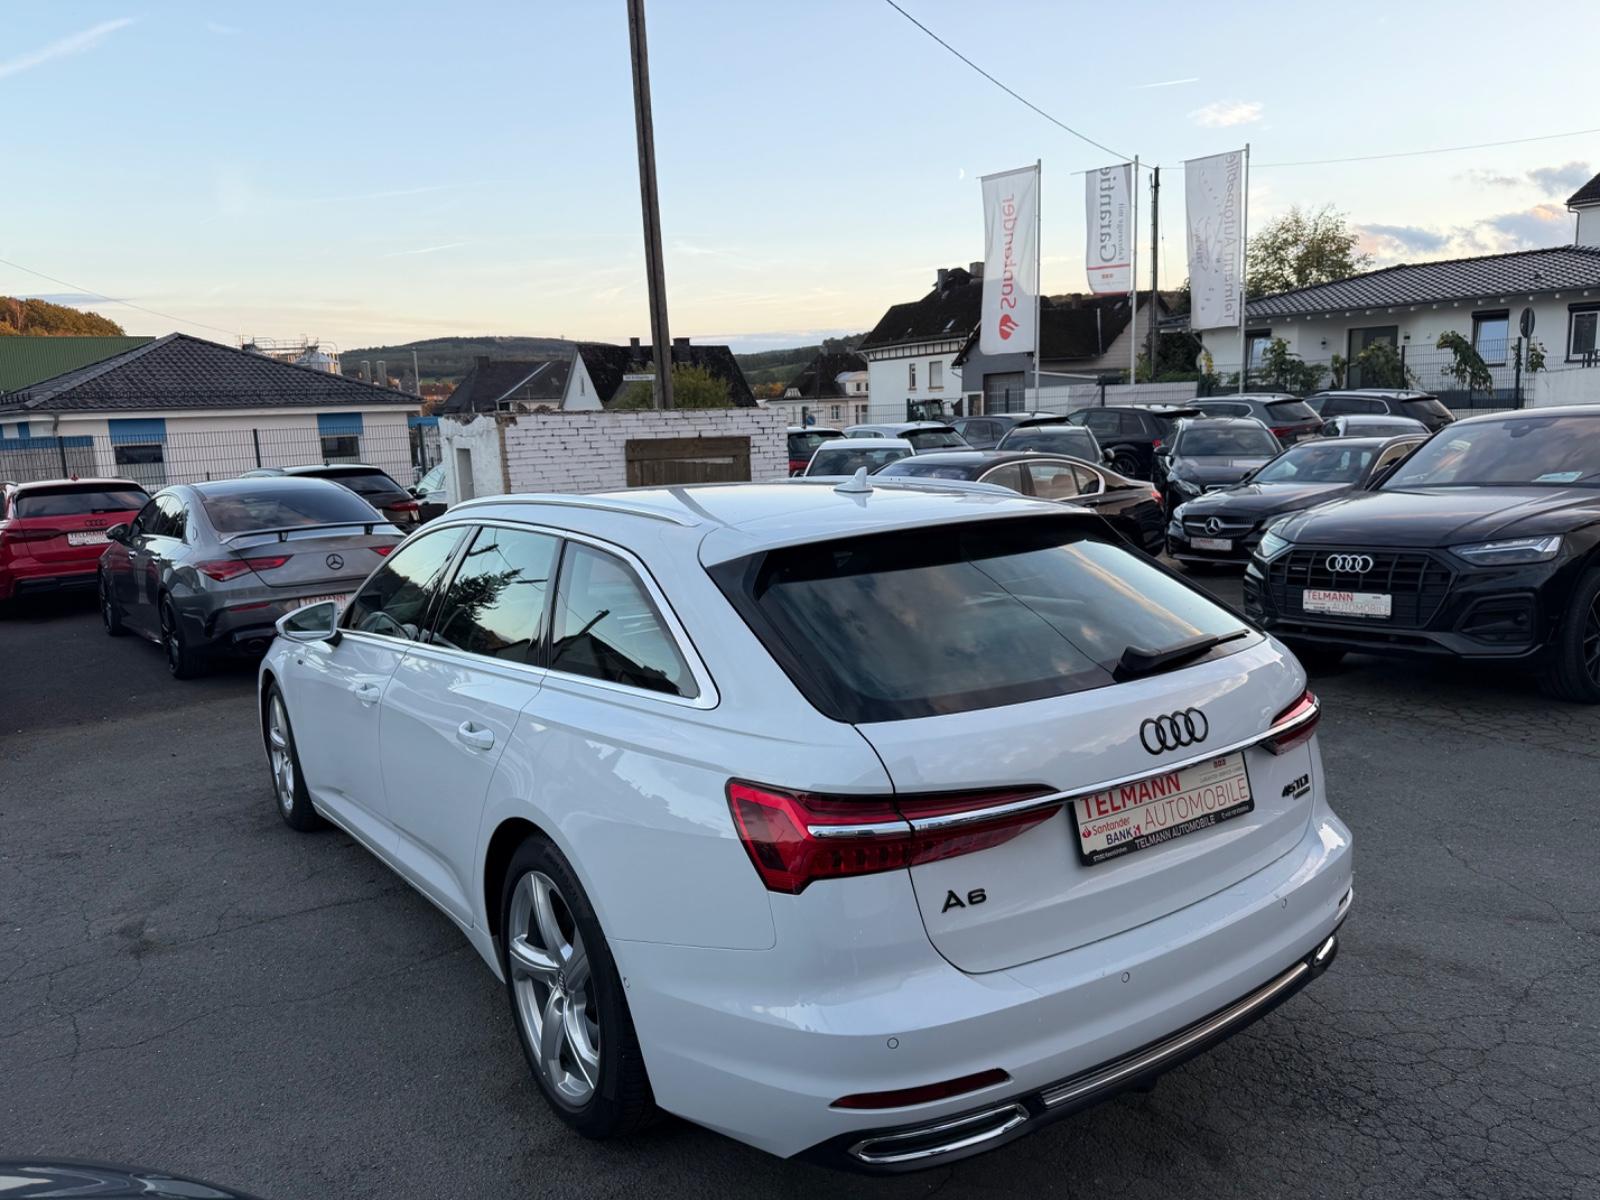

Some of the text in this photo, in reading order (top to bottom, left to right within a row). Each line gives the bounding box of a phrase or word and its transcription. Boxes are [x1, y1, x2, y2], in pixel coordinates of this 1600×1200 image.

[1307, 591, 1354, 602] TELMANN
[1332, 602, 1390, 615] AUTOMOBILE
[1081, 773, 1181, 819] TELMANN
[1145, 777, 1248, 831] AUTOMOBILE
[1092, 816, 1130, 836] Santander
[1135, 814, 1216, 849] TELMANN AUTOMOBILE
[941, 888, 987, 913] A6
